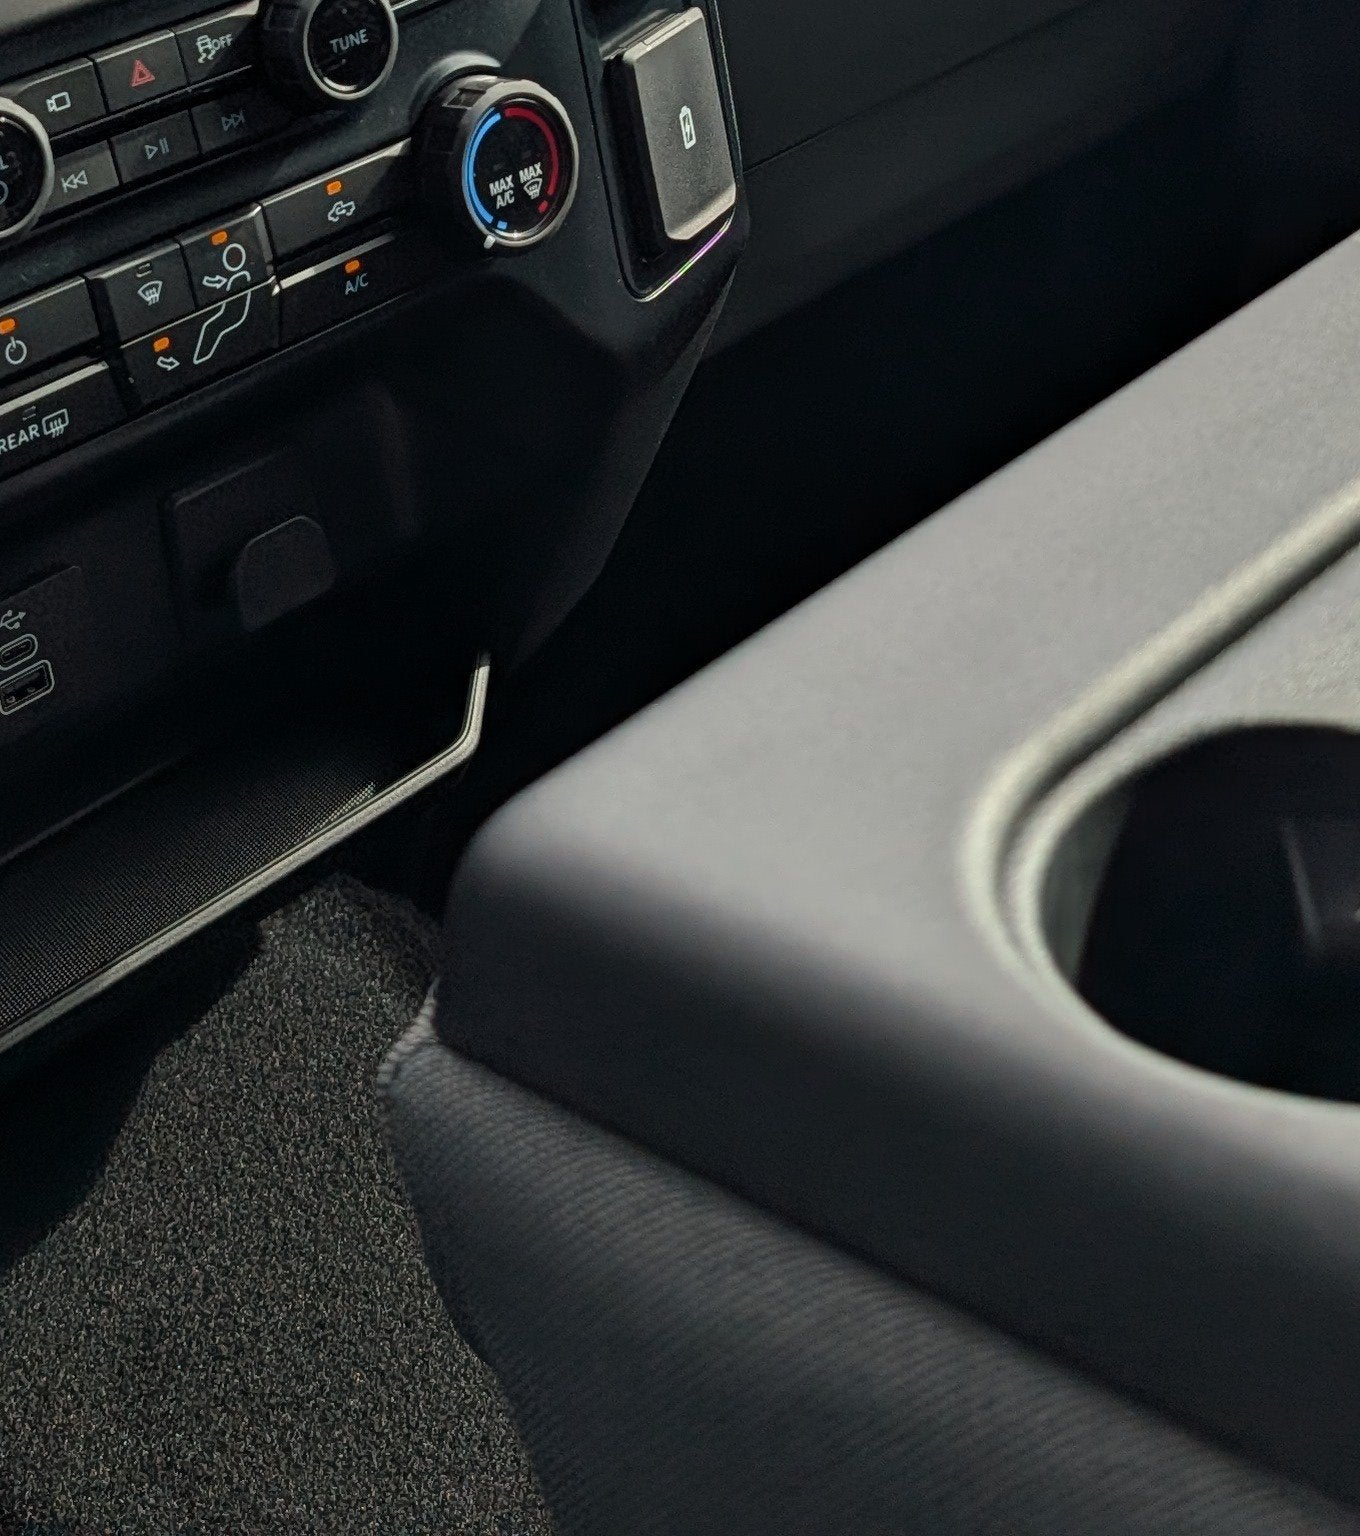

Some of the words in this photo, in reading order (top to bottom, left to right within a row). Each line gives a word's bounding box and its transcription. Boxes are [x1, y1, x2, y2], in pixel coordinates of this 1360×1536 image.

[213, 33, 234, 51] OFF
[329, 28, 370, 54] TUNE
[518, 161, 544, 185] MAX
[489, 174, 514, 197] MAX
[495, 188, 515, 210] A/C
[344, 272, 370, 297] A/C
